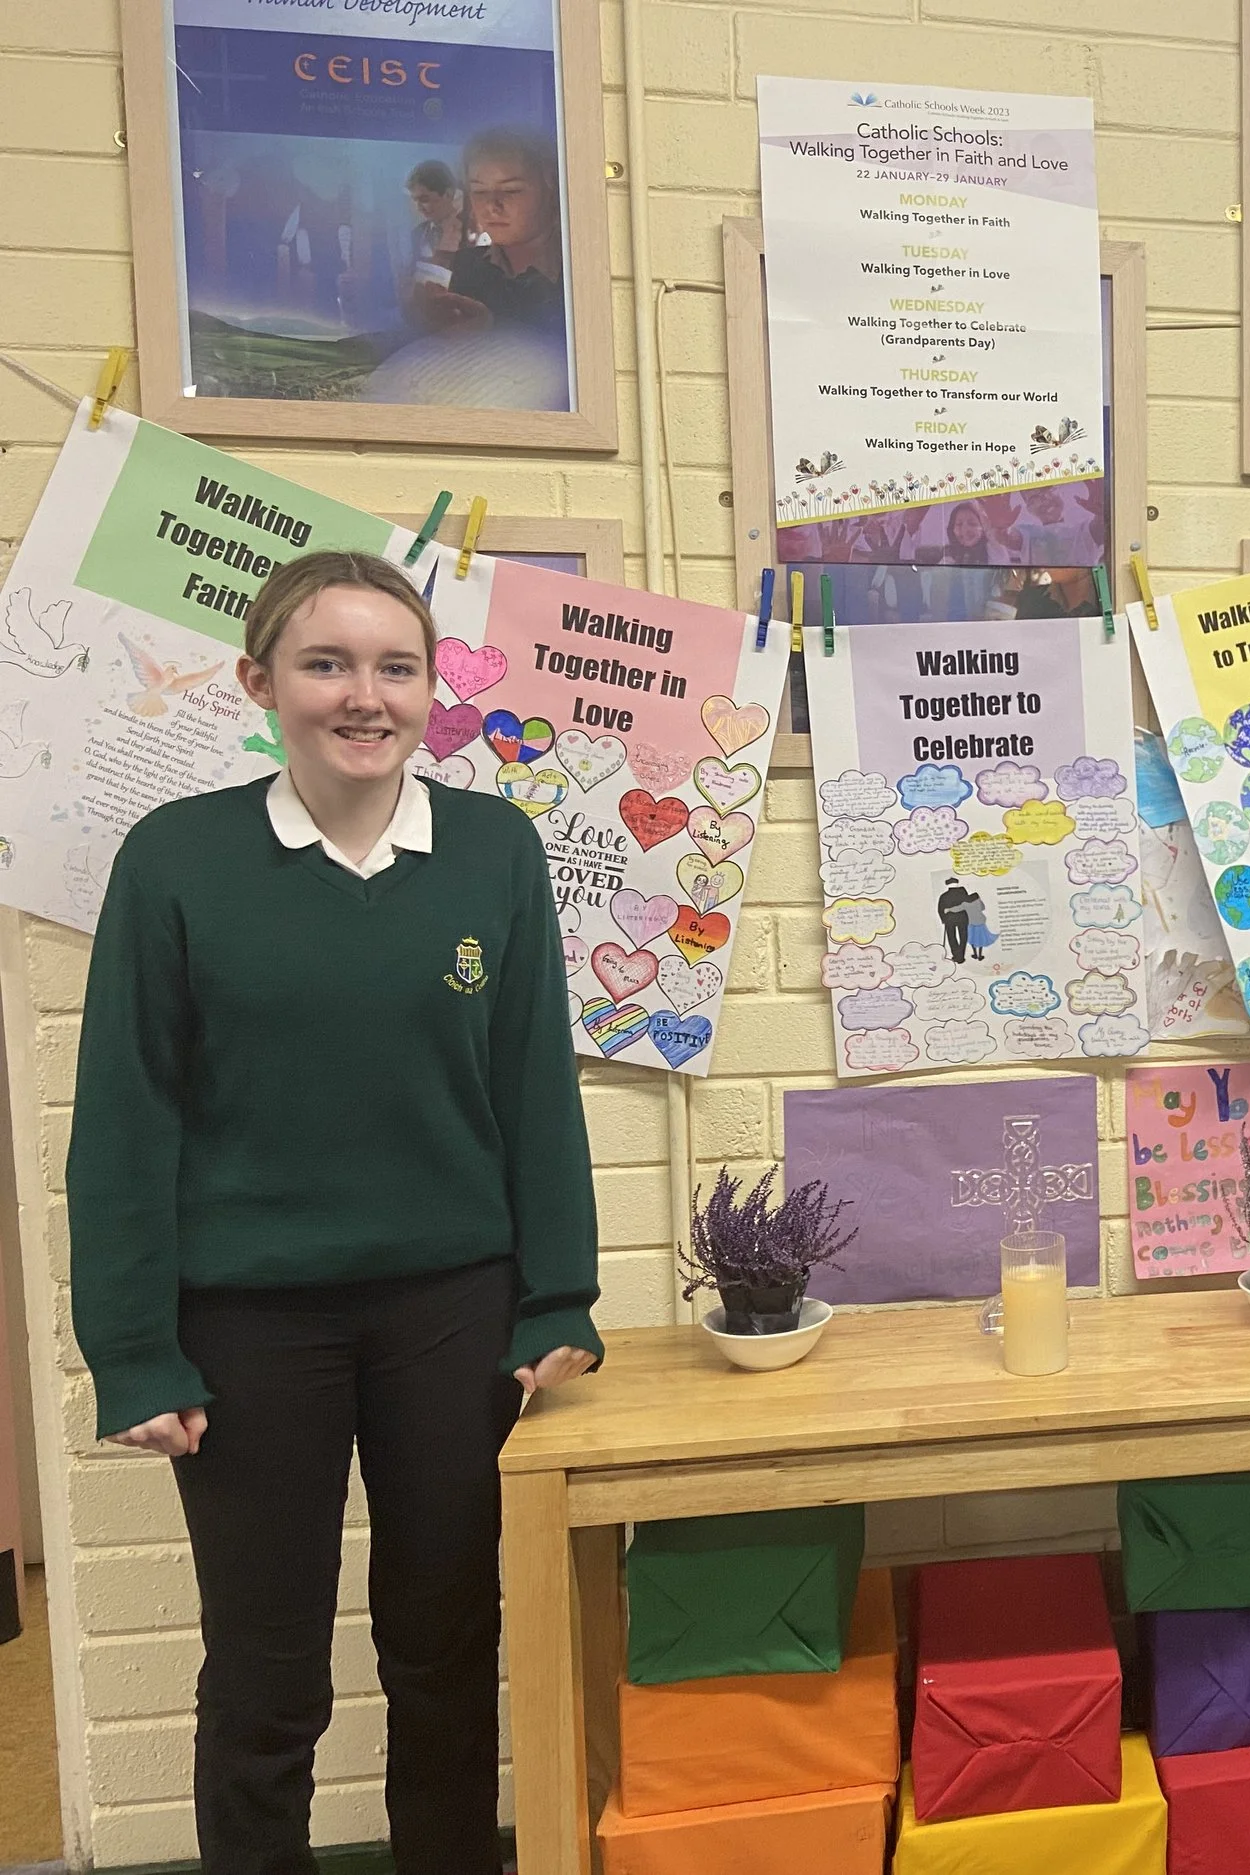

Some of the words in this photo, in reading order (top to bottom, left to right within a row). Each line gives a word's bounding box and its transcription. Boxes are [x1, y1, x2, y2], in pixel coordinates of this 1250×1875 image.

[294, 54, 441, 89] CEIST
[885, 99, 921, 109] Catholic
[924, 101, 958, 112] Schools
[960, 104, 986, 115] Week
[988, 106, 1010, 117] 2023
[857, 123, 928, 141] Catholic
[934, 126, 1003, 147] Schools:
[790, 141, 855, 161] Walking
[860, 144, 931, 163] Together
[937, 148, 949, 162] in
[955, 150, 993, 166] Faith
[998, 153, 1026, 168] and
[1032, 156, 1068, 171] Love
[857, 170, 870, 179] 22
[954, 174, 1008, 186] JANUARY
[900, 194, 967, 209] MONDAY
[860, 210, 909, 223] Walking
[913, 213, 965, 226] Together
[968, 216, 978, 226] in
[983, 216, 1010, 228] Faith
[902, 246, 969, 260] TUESDAY
[861, 263, 910, 277] Walking
[913, 266, 966, 279] Together
[969, 268, 979, 278] in
[983, 269, 1010, 280] Love
[890, 299, 984, 314] WEDNESDAY
[848, 316, 896, 329] Walking
[900, 318, 952, 332] Together
[955, 320, 967, 330] to
[971, 321, 1026, 332] Celebrate
[881, 335, 965, 348] (Grandparents
[969, 337, 995, 350] Day)
[900, 369, 978, 383] THURSDAY
[819, 385, 867, 399] Walking
[871, 387, 923, 400] Together
[926, 388, 937, 398] to
[941, 389, 997, 401] Transform
[1002, 392, 1020, 401] our
[1024, 392, 1058, 402] World
[915, 421, 967, 434] FRIDAY
[866, 439, 913, 452] Walking
[917, 441, 968, 453] Together
[972, 442, 982, 452] in
[985, 443, 1016, 455] Hope
[195, 476, 312, 548] Walking
[182, 572, 254, 621] Faith
[562, 603, 674, 653] Walking
[916, 651, 1019, 676] Walking
[1213, 648, 1234, 668] to
[534, 644, 657, 694] Together
[659, 669, 687, 699] in
[207, 683, 242, 705] Come
[183, 690, 209, 708] Holy
[210, 701, 241, 721] Spirit
[573, 697, 633, 732] Love
[900, 693, 1014, 720] Together
[1017, 692, 1041, 715] to
[103, 707, 117, 716] and
[118, 710, 138, 724] kindle
[147, 723, 163, 733] them
[165, 729, 175, 738] the
[194, 742, 210, 750] your
[174, 710, 186, 718] fill
[186, 714, 196, 722] the
[197, 717, 218, 730] hearts
[171, 720, 178, 728] of
[191, 728, 218, 742] faithful
[116, 736, 130, 746] and
[131, 740, 145, 750] they
[146, 746, 161, 756] shall
[126, 727, 143, 738] Send
[142, 733, 160, 743] forth
[160, 741, 176, 749] your
[176, 746, 194, 757] Spirit
[914, 732, 1033, 762] Celebrate
[415, 765, 450, 783] Think
[548, 810, 628, 852] Love
[709, 820, 721, 837] By
[693, 829, 730, 849] Listening
[545, 842, 570, 853] ONE
[572, 846, 628, 865] ANOTHER
[584, 860, 602, 870] HAVE
[556, 886, 607, 926] you
[689, 922, 704, 936] By
[675, 935, 715, 952] Listening
[602, 954, 618, 969] Going
[657, 1018, 668, 1027] BE
[653, 1030, 711, 1047] POSITIVE
[1132, 1076, 1196, 1128] May
[1132, 1133, 1168, 1166] be
[1180, 1132, 1236, 1162] less
